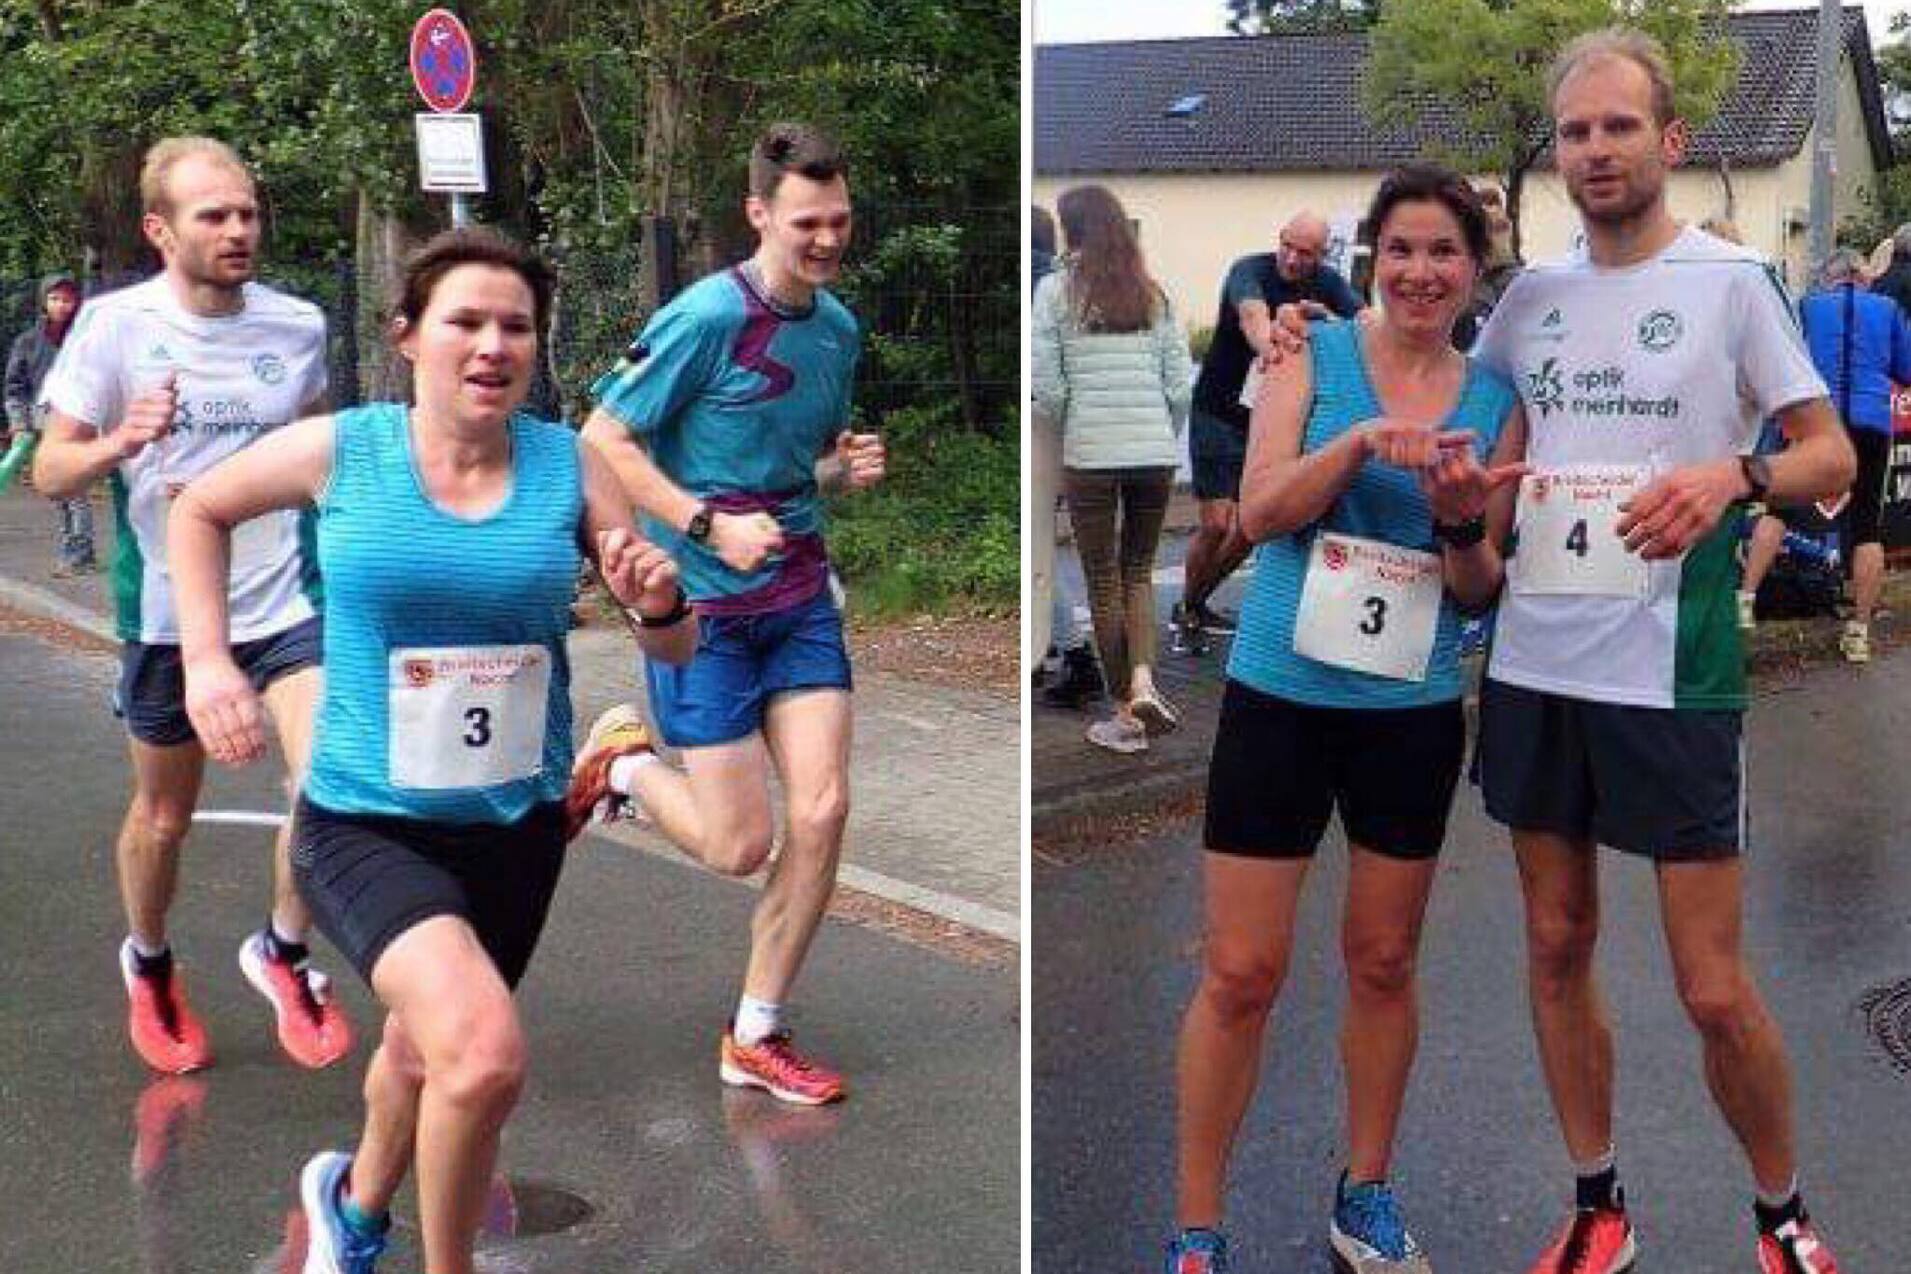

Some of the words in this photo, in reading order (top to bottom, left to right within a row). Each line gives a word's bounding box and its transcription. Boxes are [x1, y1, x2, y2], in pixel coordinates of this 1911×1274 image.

[1566, 518, 1588, 557] 4
[1360, 596, 1387, 635] 3
[464, 707, 490, 747] 3
